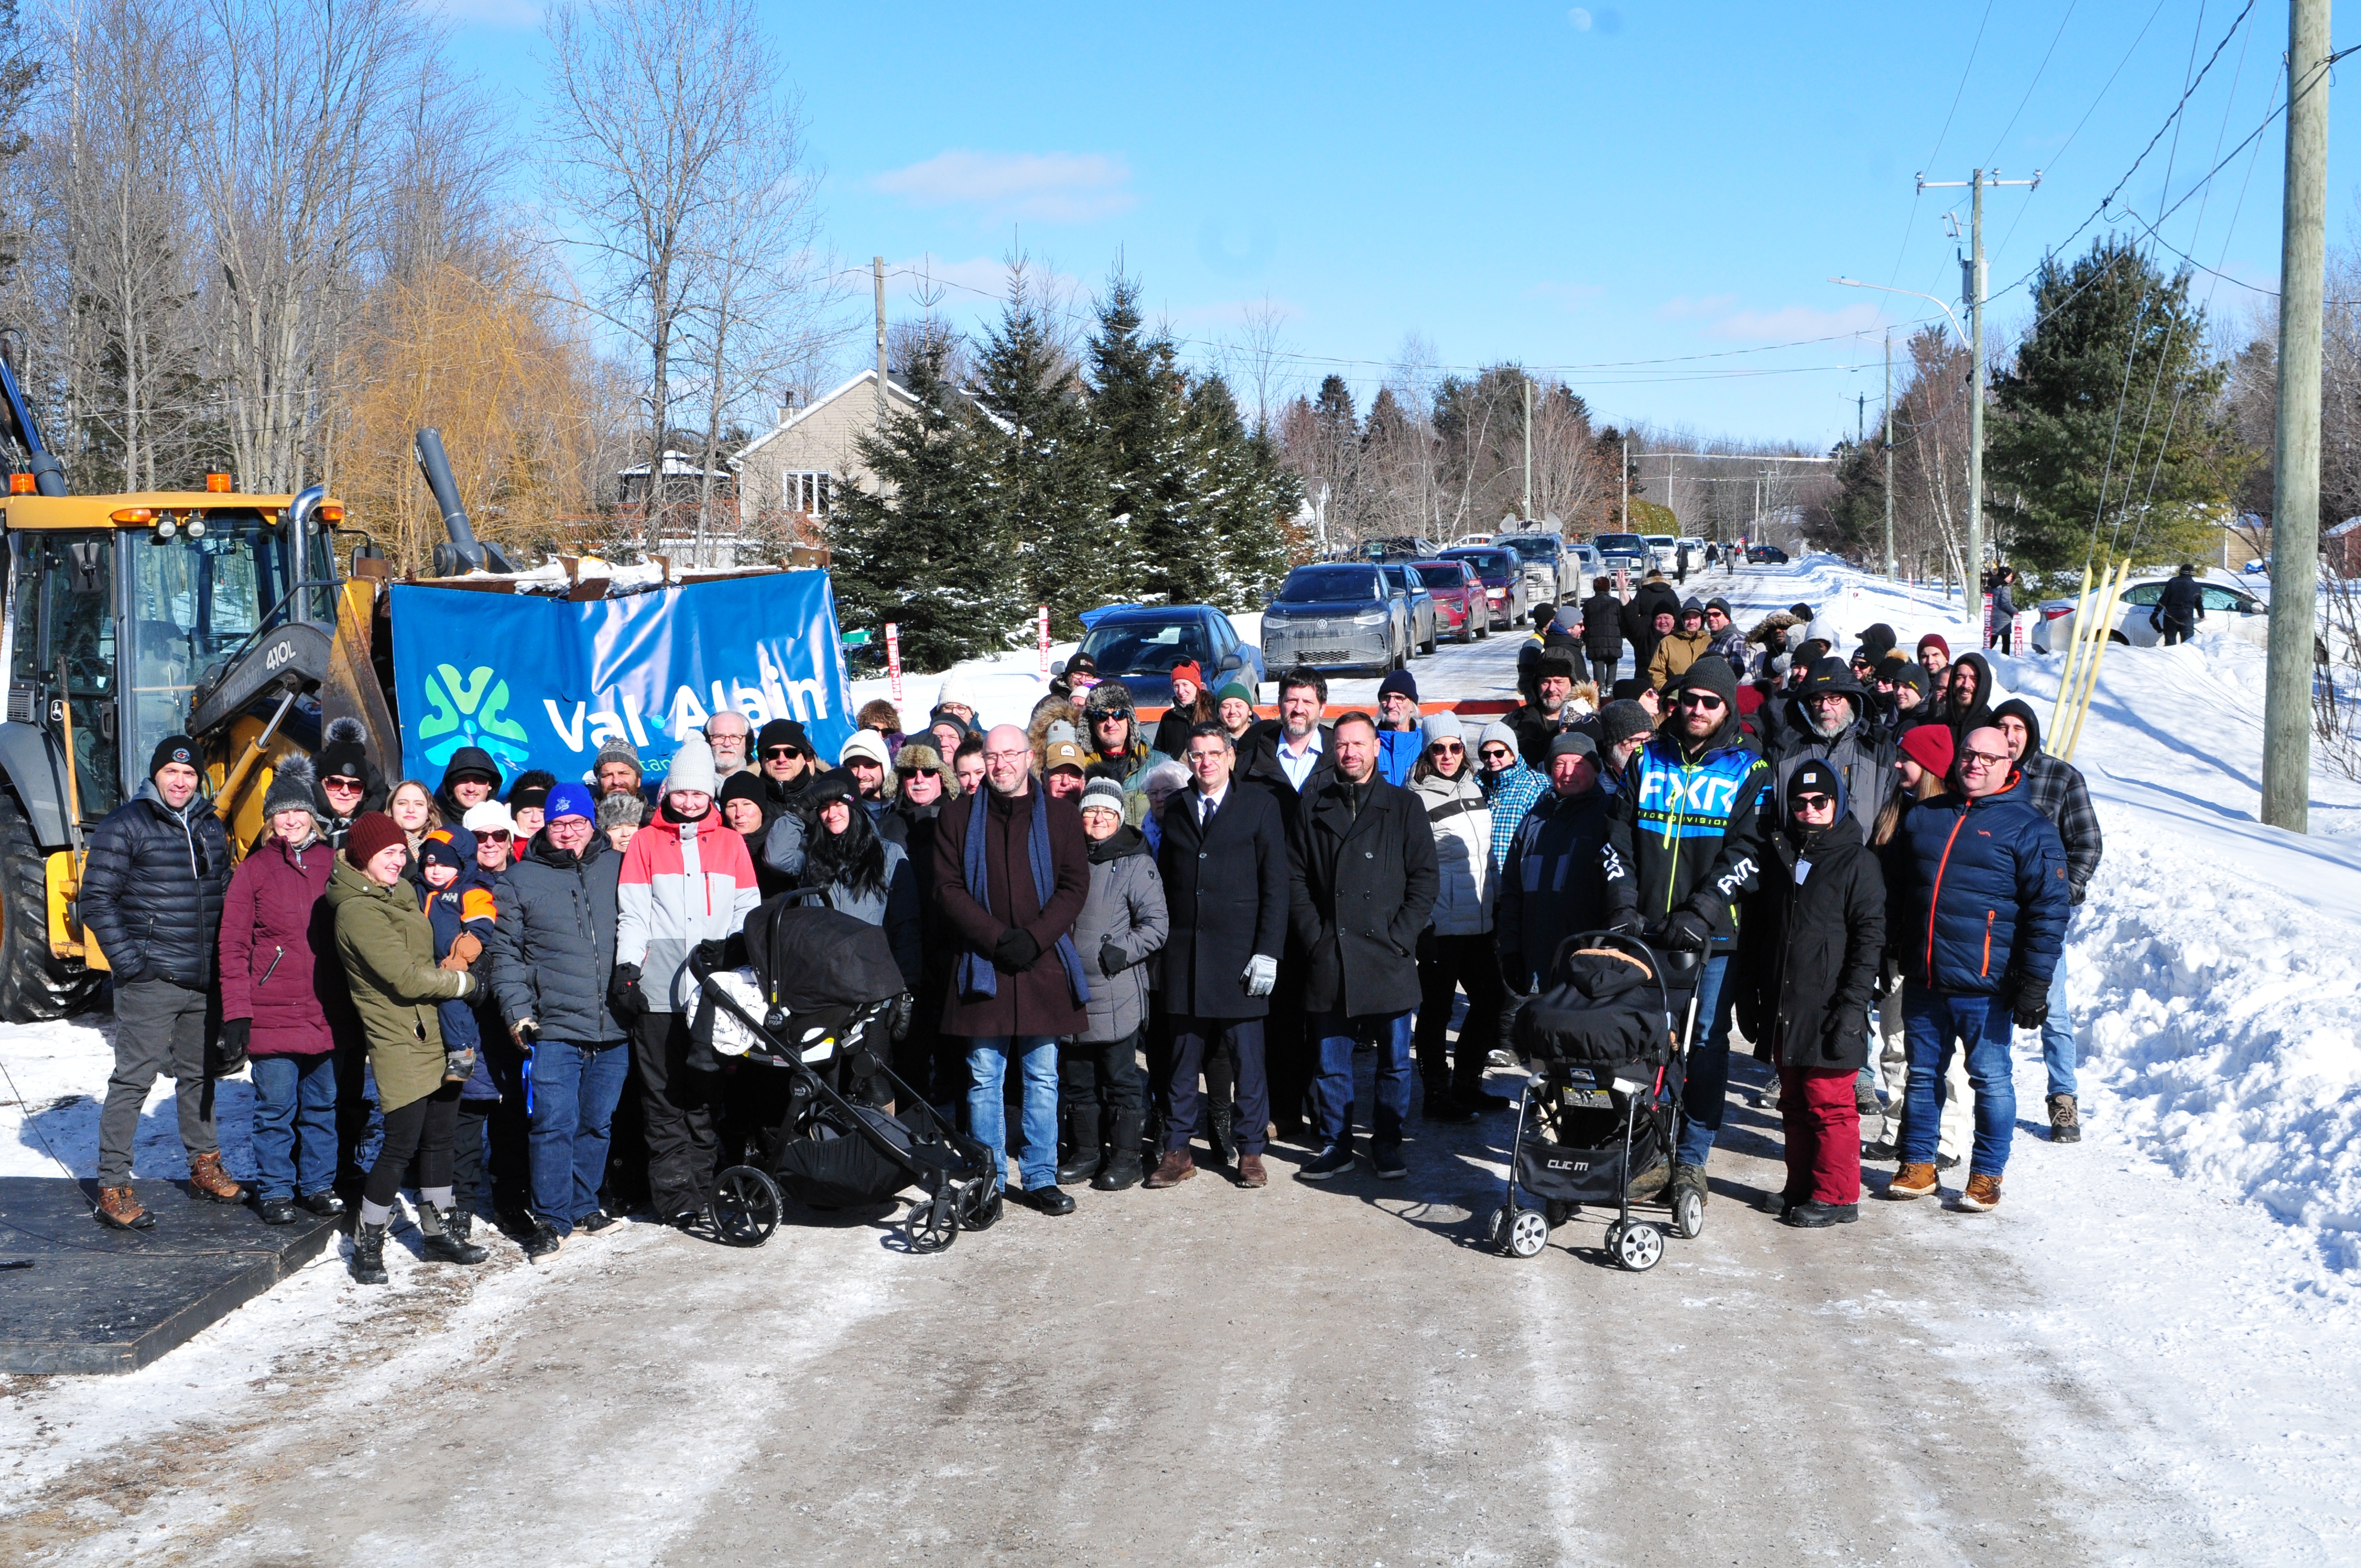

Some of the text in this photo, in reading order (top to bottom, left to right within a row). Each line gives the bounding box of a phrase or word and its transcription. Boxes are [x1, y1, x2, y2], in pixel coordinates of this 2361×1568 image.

[265, 640, 296, 671] 410L
[222, 665, 263, 710] Plumbin
[543, 665, 828, 753] Val Alain
[1638, 771, 1739, 813] FXR
[1717, 857, 1760, 896] FXR
